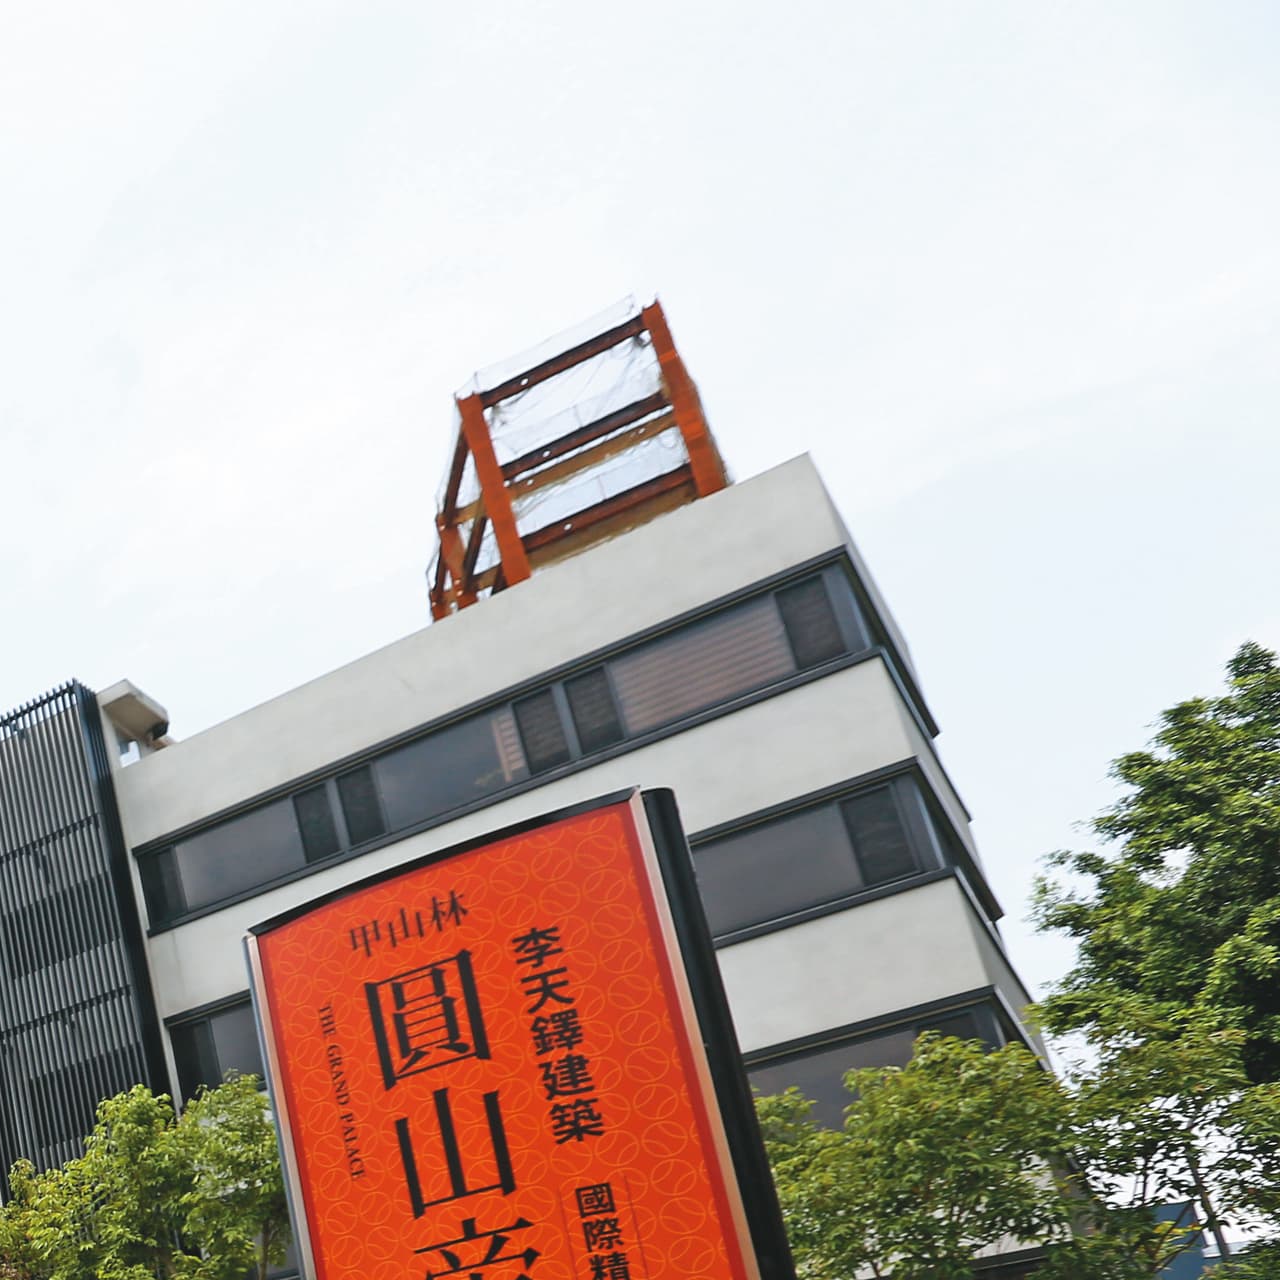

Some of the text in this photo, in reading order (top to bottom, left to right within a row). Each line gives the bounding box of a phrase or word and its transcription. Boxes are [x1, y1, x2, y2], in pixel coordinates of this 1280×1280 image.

[349, 889, 469, 958] 甲山林
[319, 1004, 367, 1180] THE GRAND PALACE
[511, 926, 605, 1145] 李天鐸建築
